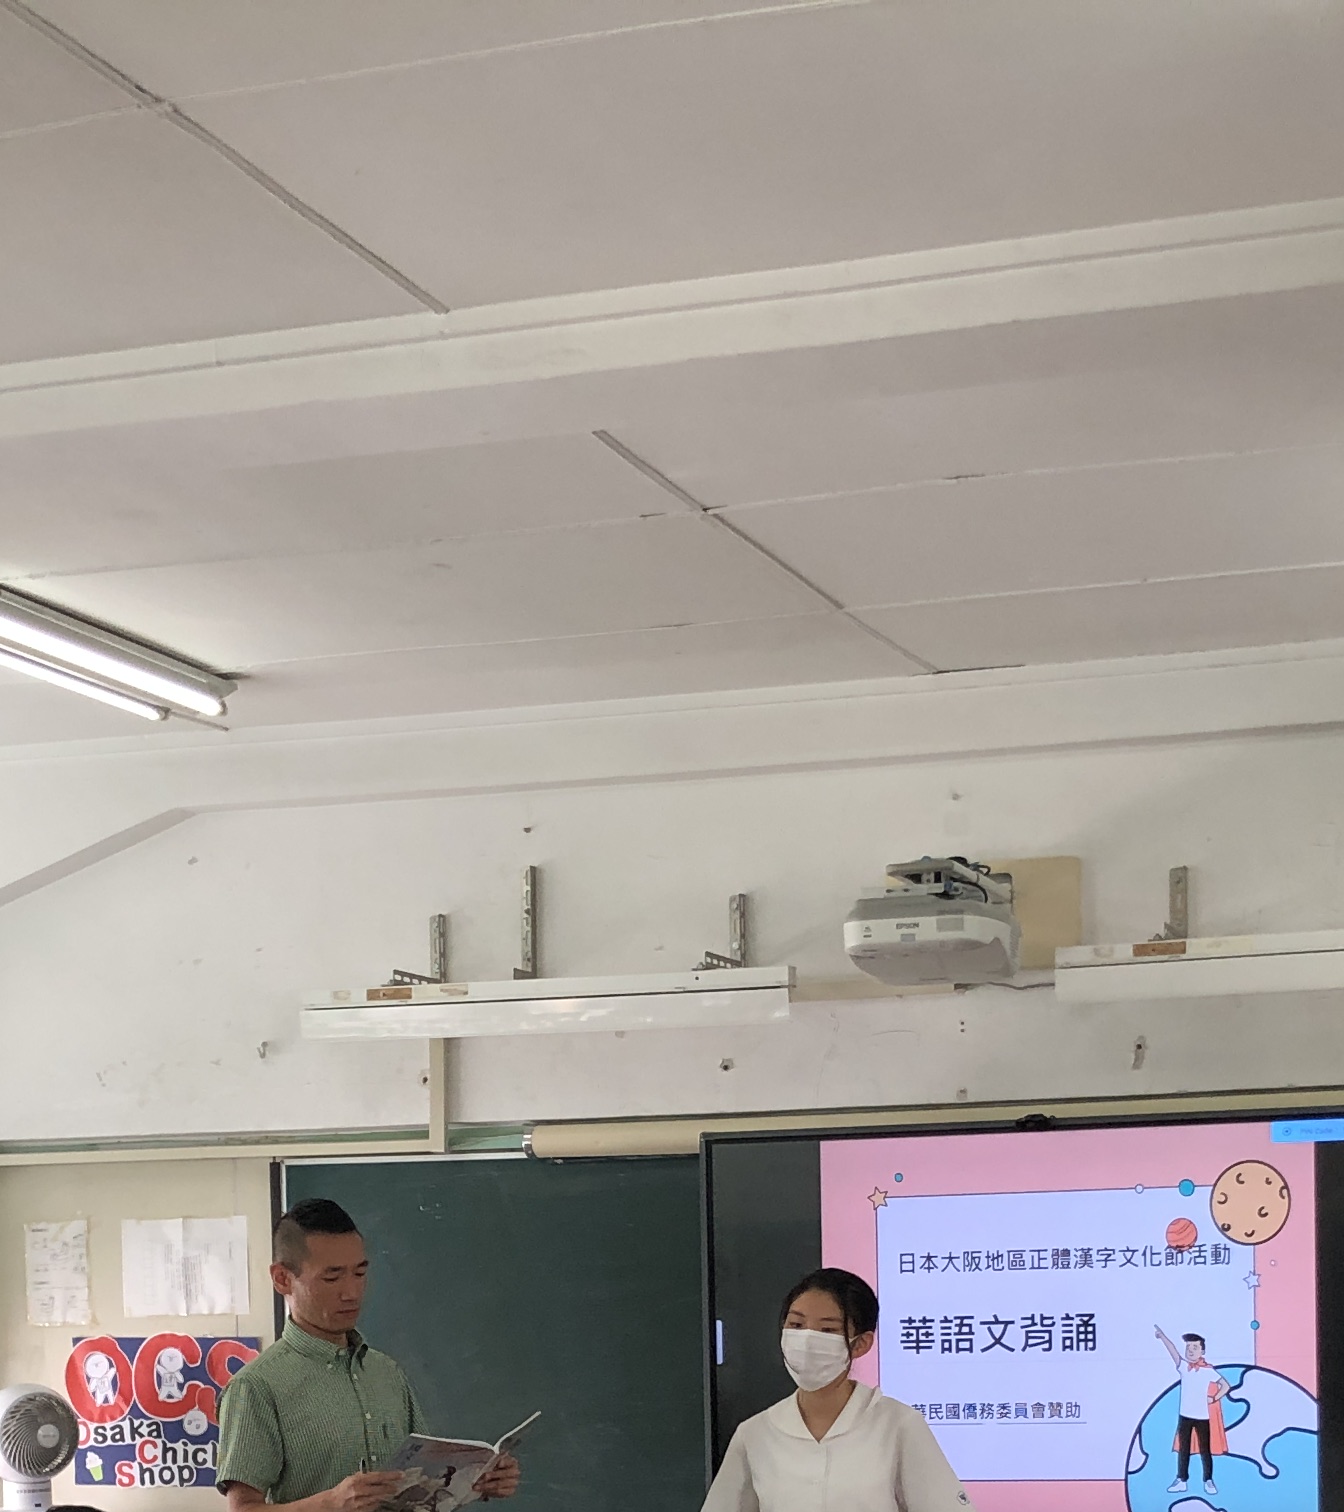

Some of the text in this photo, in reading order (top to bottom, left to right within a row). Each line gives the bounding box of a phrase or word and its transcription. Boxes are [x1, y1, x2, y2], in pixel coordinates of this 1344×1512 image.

[899, 1244, 1231, 1274] 日本大阪地區正體漢字文化節活動
[899, 1312, 1097, 1354] 華語文背誦
[117, 1462, 195, 1488] Shop
